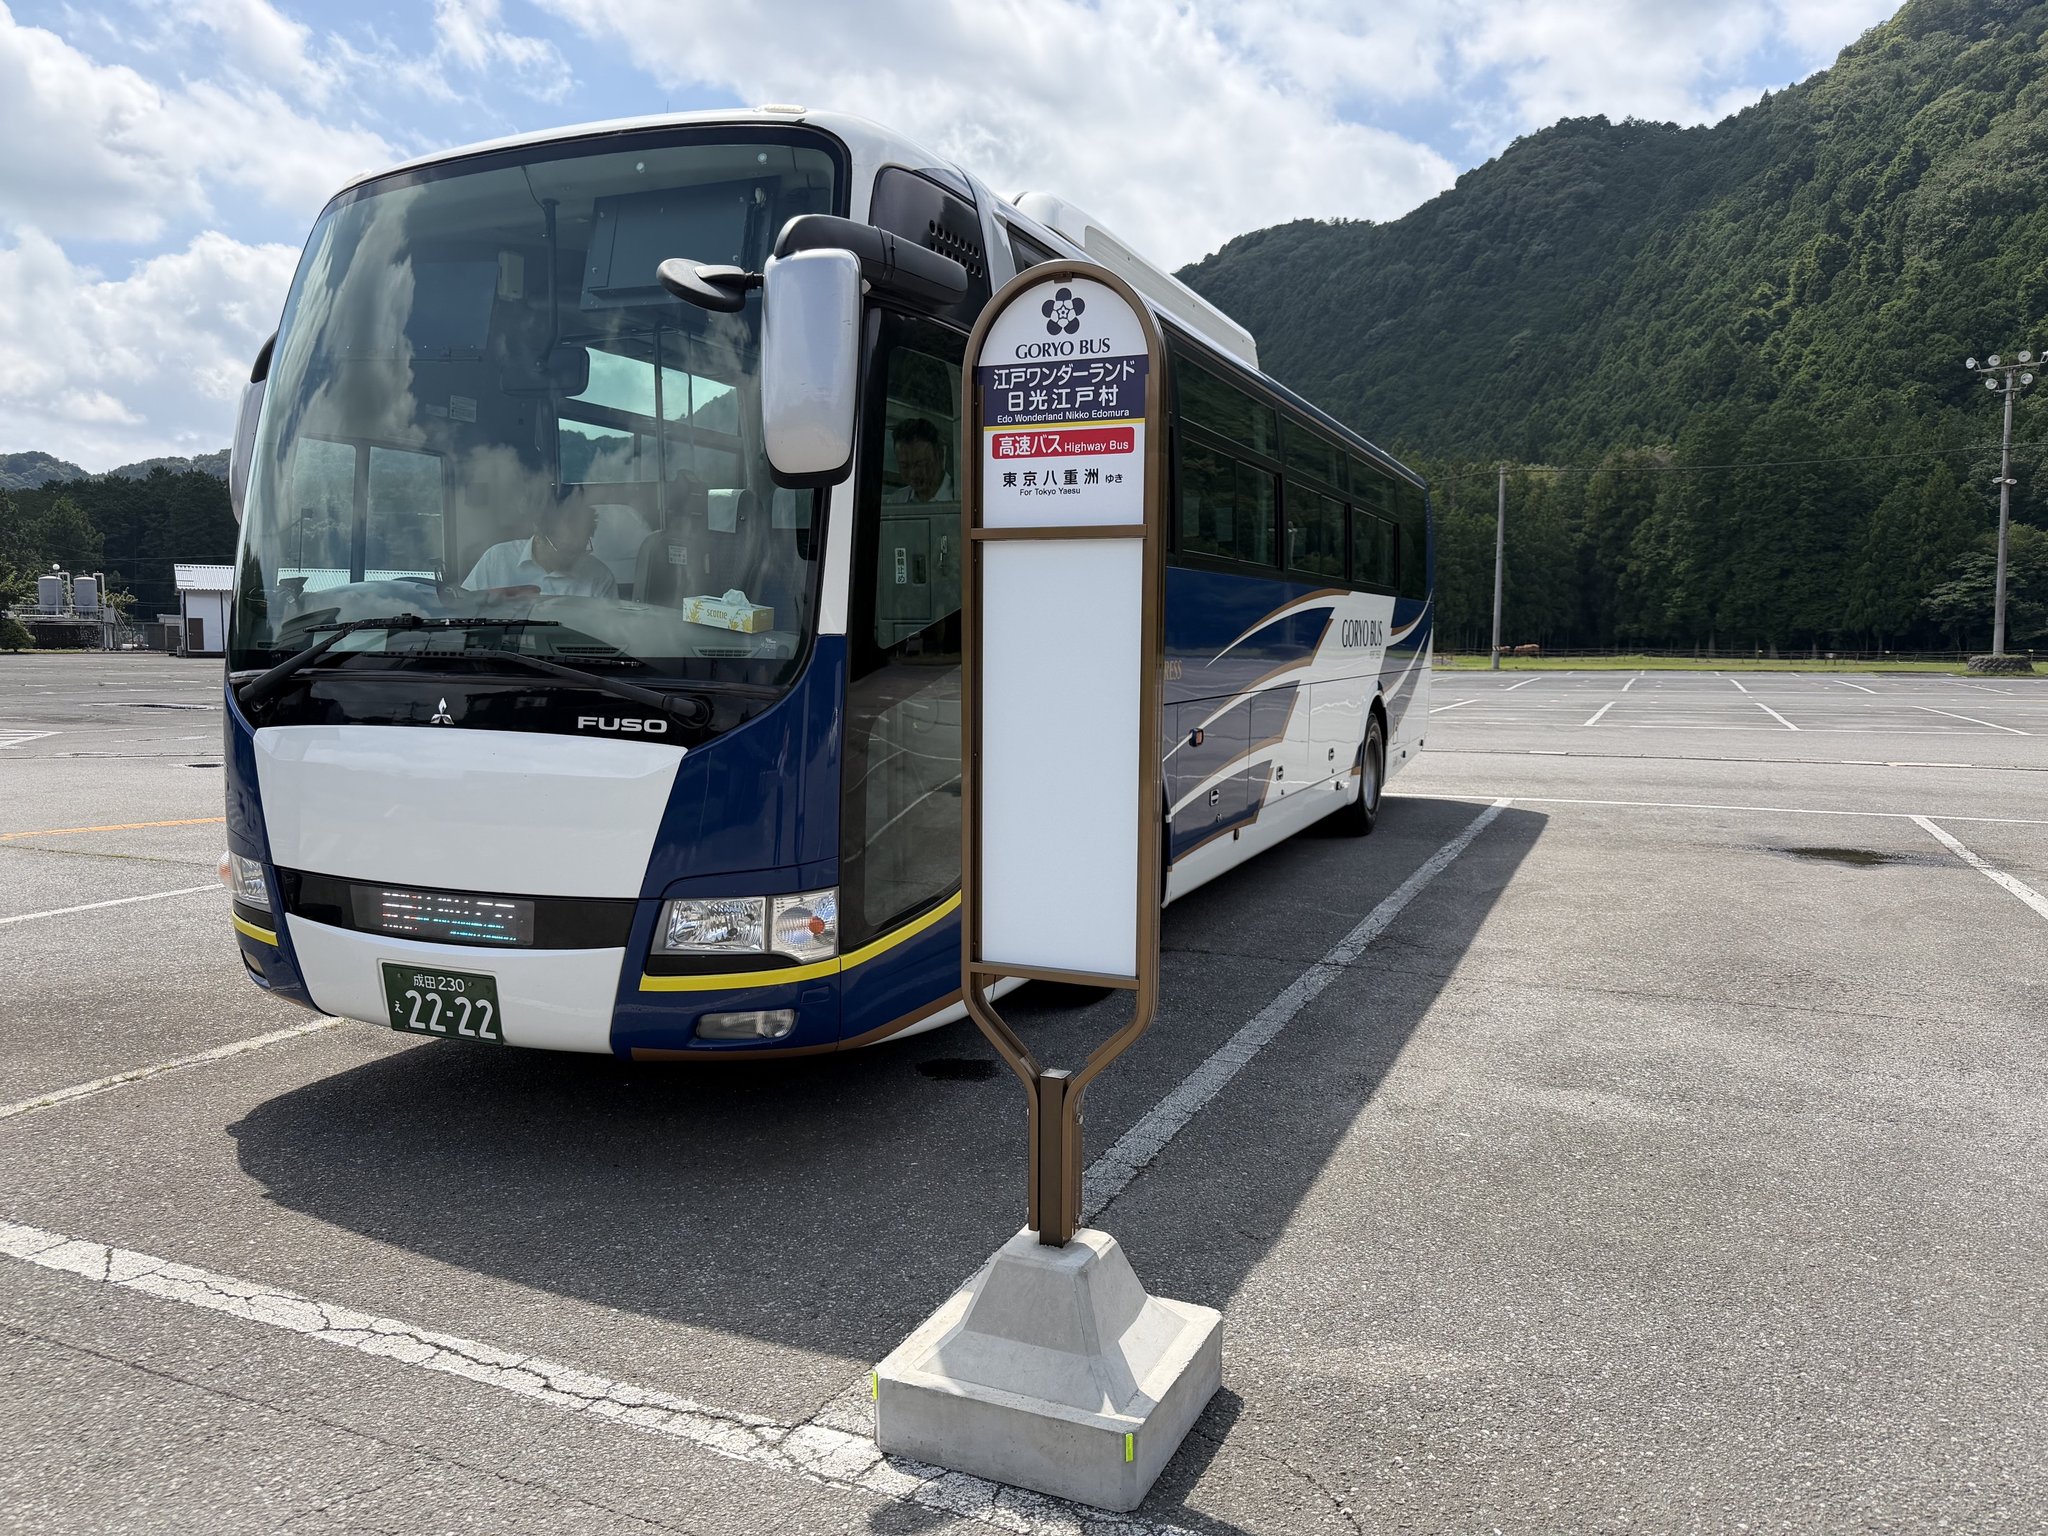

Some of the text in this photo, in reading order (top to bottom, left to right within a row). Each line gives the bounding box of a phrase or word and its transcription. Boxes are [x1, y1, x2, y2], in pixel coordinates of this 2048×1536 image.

[1015, 337, 1111, 359] GORYO BUS
[993, 360, 1136, 389] 江戸ワンダーランド
[1008, 384, 1119, 412] 日光江戸村
[997, 408, 1130, 423] Edo Wonderland Nikko Edomura
[999, 433, 1129, 457] 高速バス Highway Bus
[1002, 468, 1124, 488] 東京八重洲 ゆき
[1019, 487, 1081, 496] For Tokyo Yaesu
[706, 607, 728, 620] scottie
[1341, 619, 1383, 648] GORYO BUS
[577, 716, 668, 733] FUSO
[413, 974, 465, 993] 成田 230
[394, 989, 497, 1040] え 22-22
